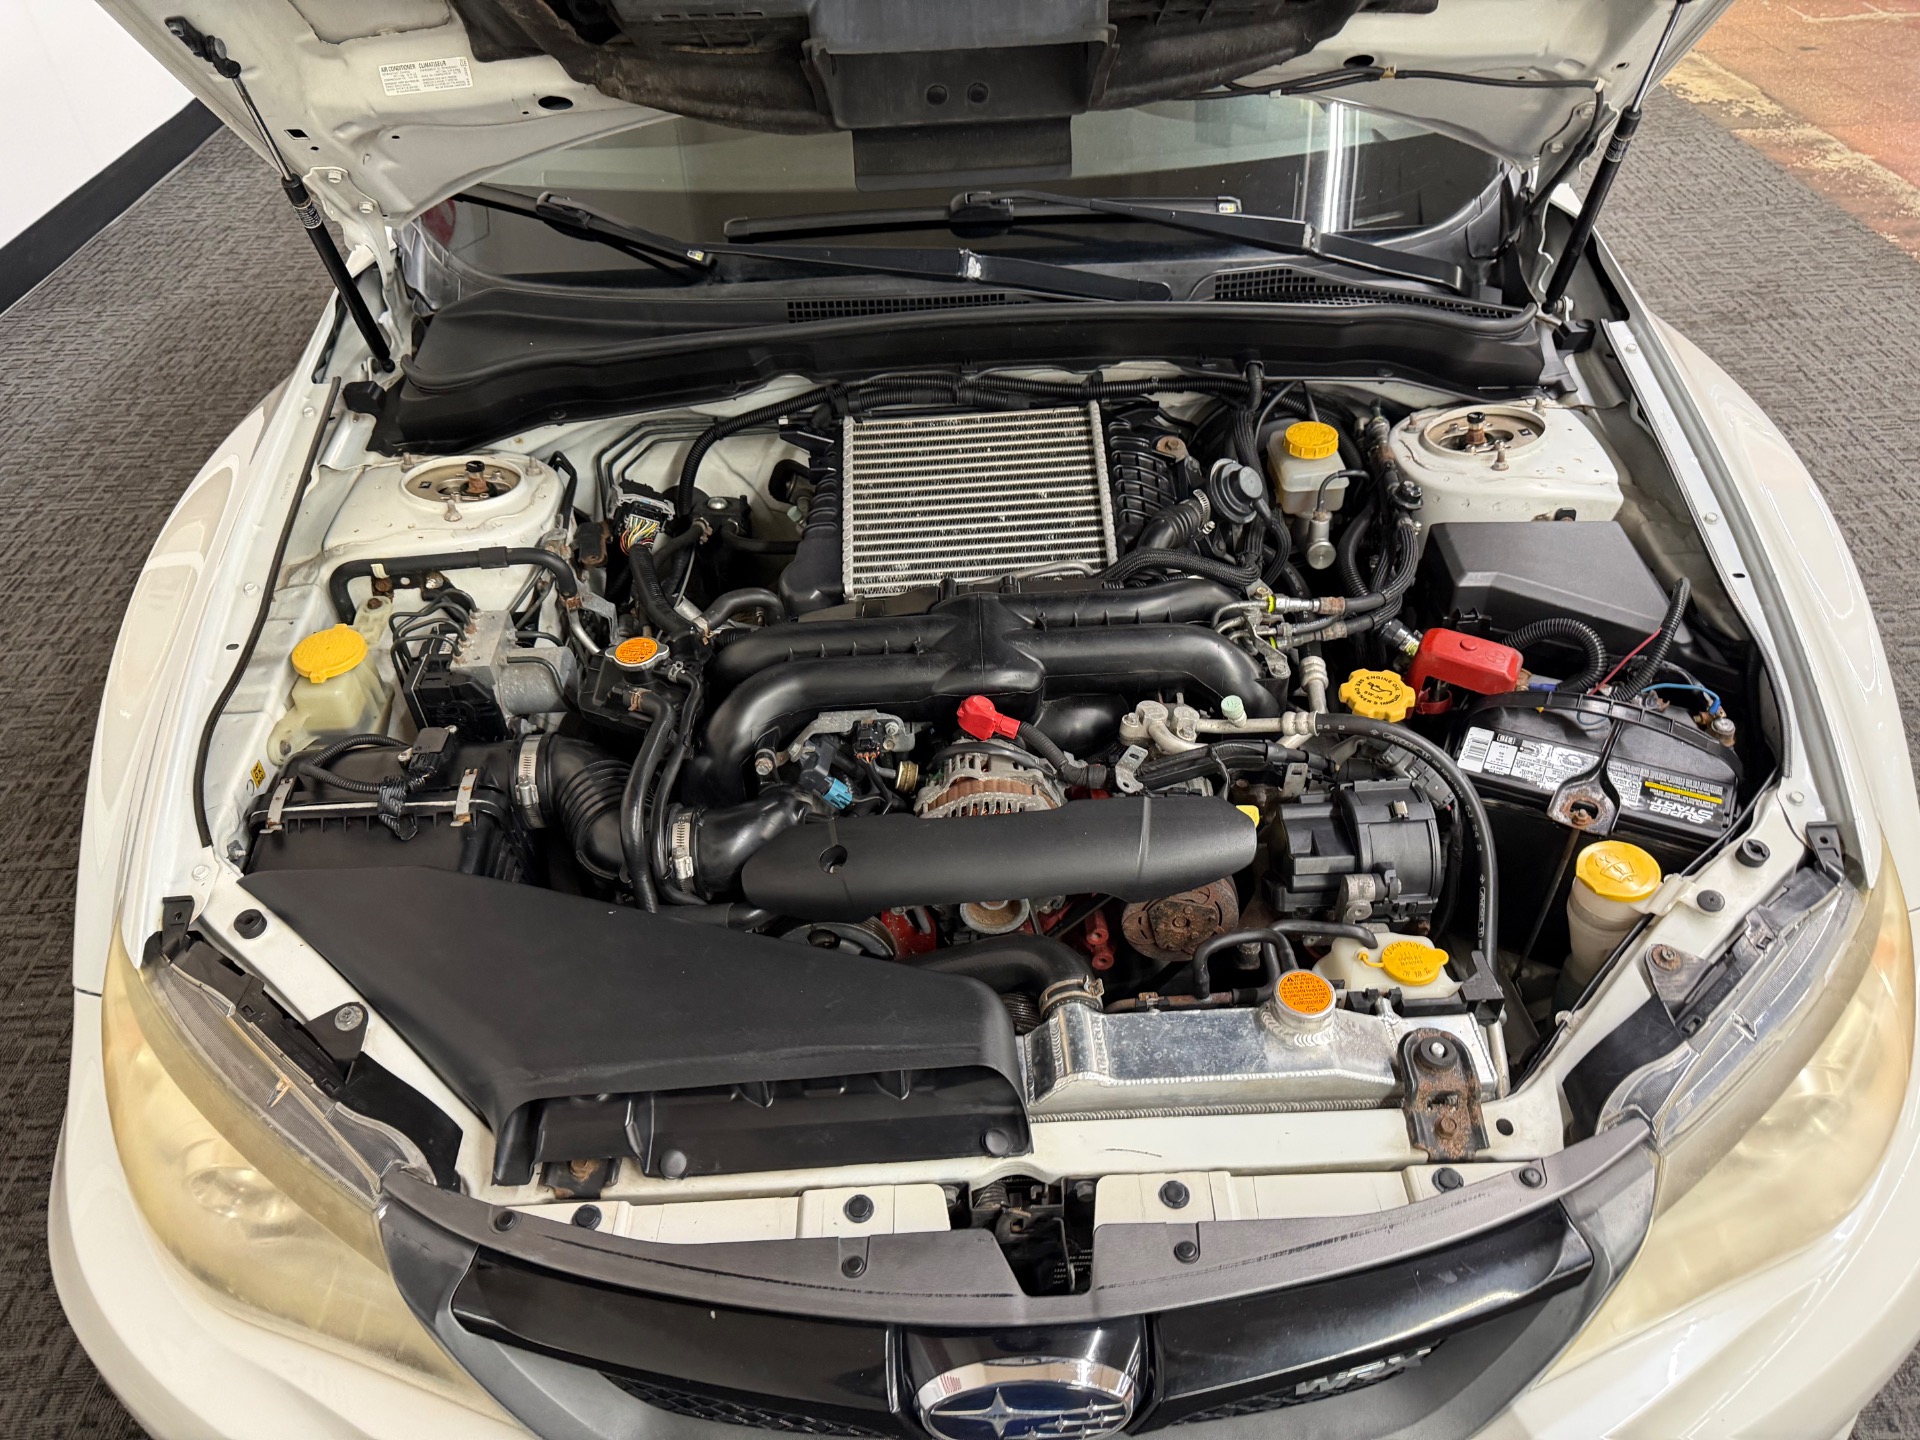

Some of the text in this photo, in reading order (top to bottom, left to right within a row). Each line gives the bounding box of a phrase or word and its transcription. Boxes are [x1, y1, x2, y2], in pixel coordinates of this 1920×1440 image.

[388, 64, 416, 72] CONDITIONER
[419, 60, 447, 69] CLIMATISEUR
[1366, 675, 1400, 691] ENGINE OIL
[1649, 804, 1705, 824] SUPER
[1650, 797, 1713, 820] START
[1384, 941, 1427, 956] COOLANT
[1296, 1347, 1431, 1395] WRX
